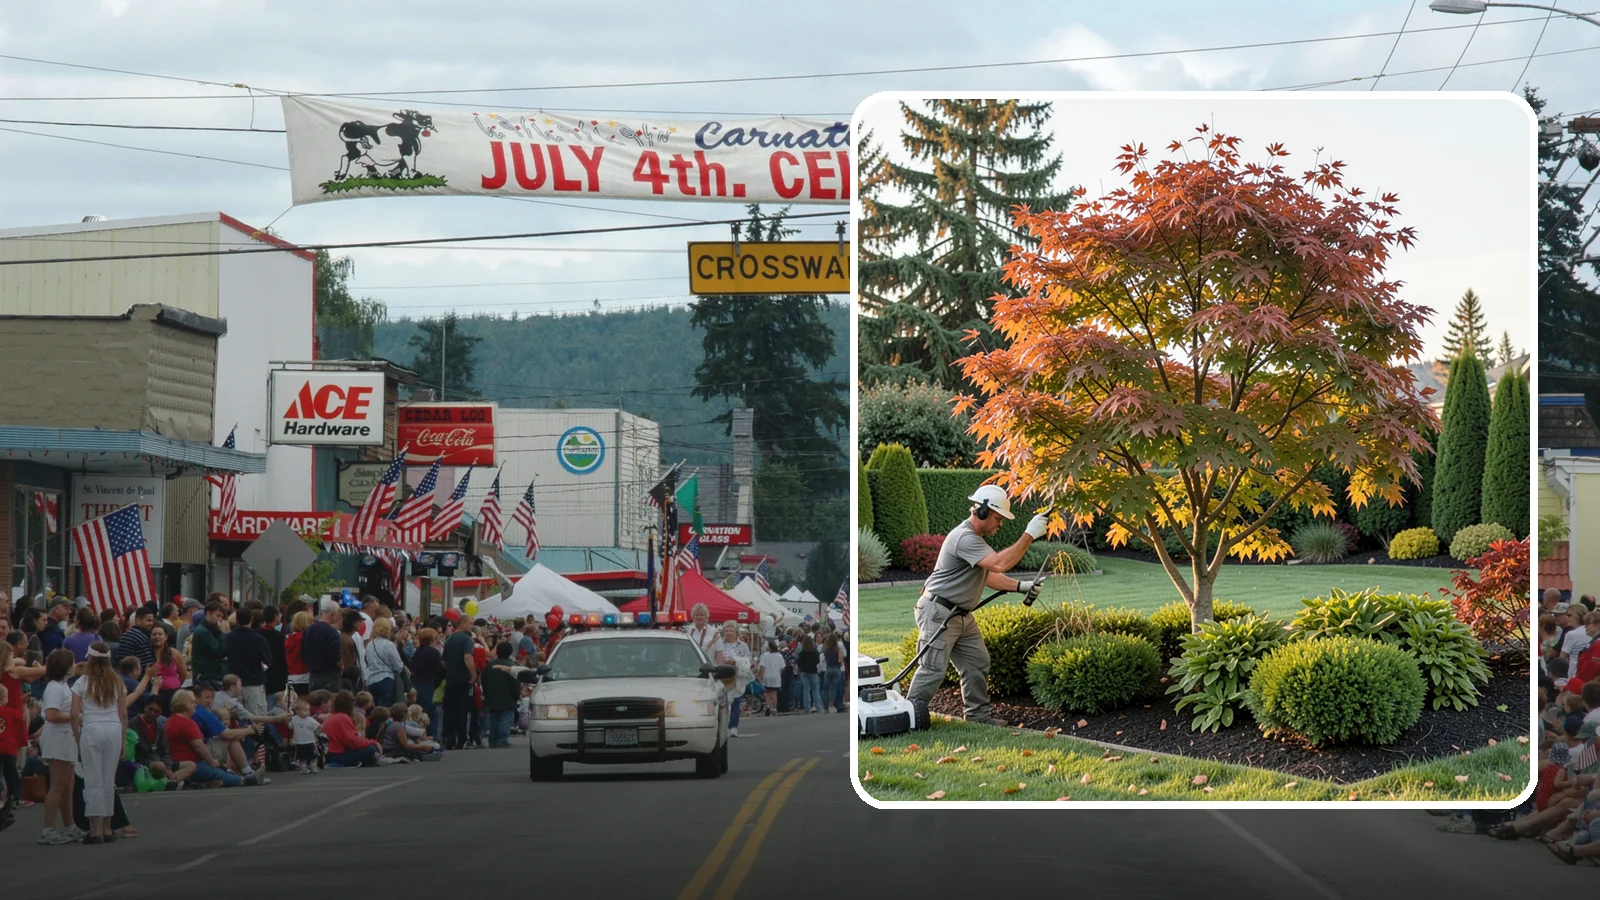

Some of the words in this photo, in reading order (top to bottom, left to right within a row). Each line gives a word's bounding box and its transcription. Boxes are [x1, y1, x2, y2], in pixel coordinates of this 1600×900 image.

[481, 141, 605, 192] JULY
[632, 150, 746, 197] 4th.
[697, 254, 850, 279] CROSSWA
[283, 380, 373, 420] ACE
[406, 410, 453, 422] CEDAR
[283, 421, 371, 436] Hardware
[416, 428, 477, 447] Coca-Cola
[353, 467, 384, 480] Simpl
[83, 485, 94, 494] St.
[95, 485, 124, 495] Vincent
[126, 486, 135, 495] de
[137, 486, 155, 495] Paul
[688, 527, 741, 535] CRNATION
[699, 535, 730, 543] GLASS
